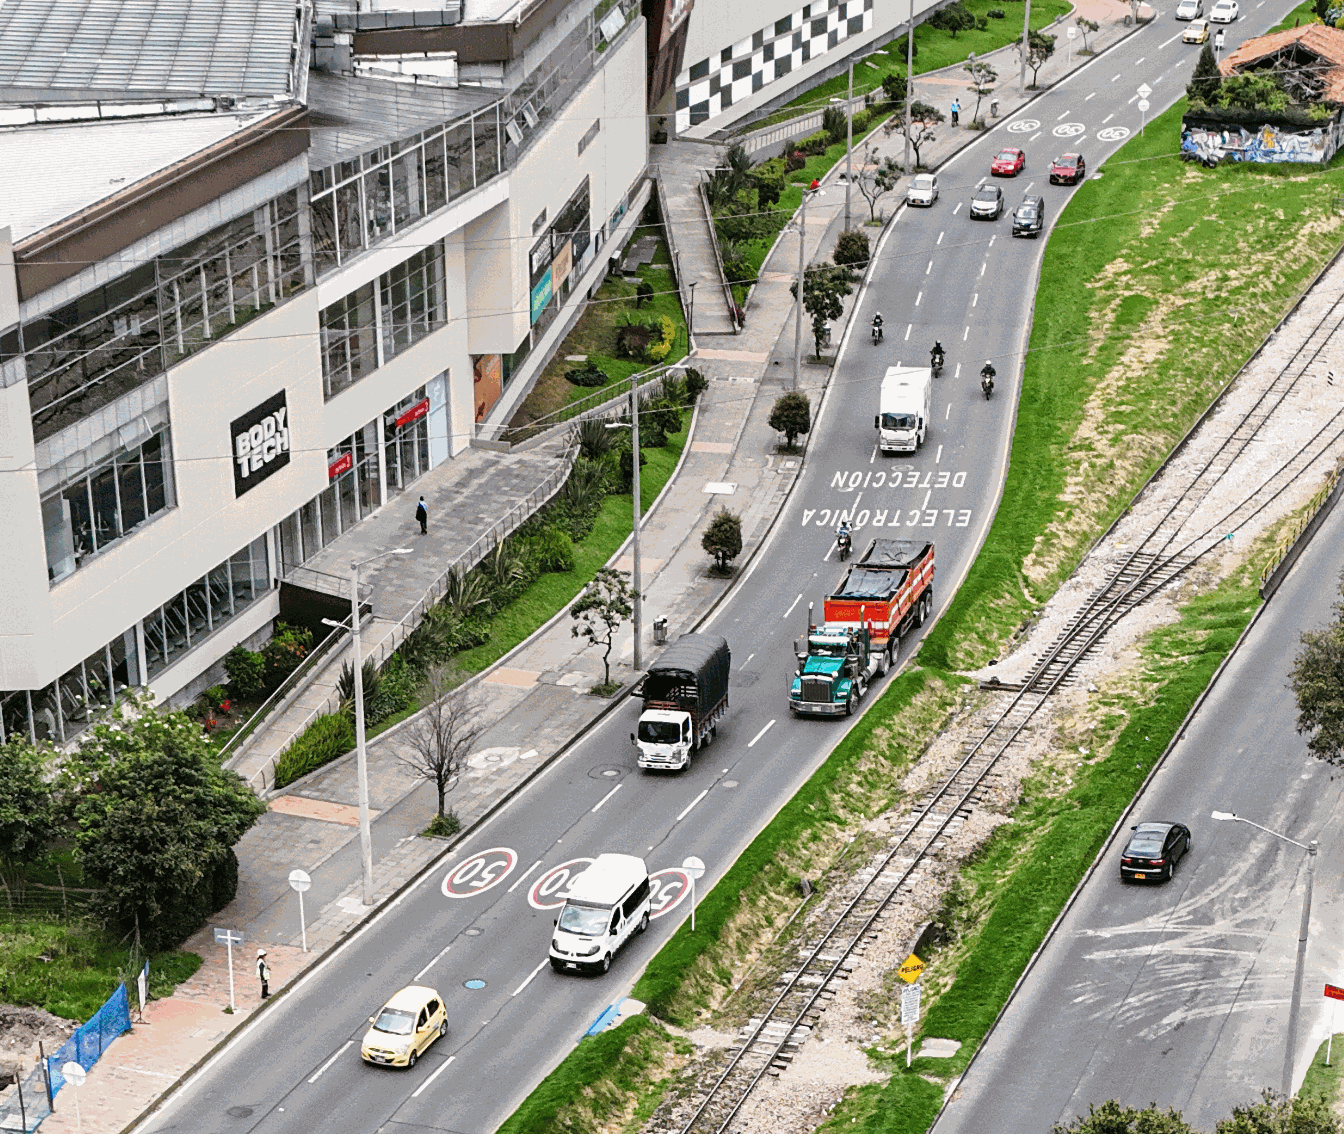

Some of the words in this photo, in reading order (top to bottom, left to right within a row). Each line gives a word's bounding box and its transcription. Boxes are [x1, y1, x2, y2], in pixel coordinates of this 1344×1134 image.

[236, 406, 287, 458] BODY
[237, 427, 289, 478] TECH
[830, 471, 967, 492] DETECCIÓN
[801, 509, 972, 531] ELECTRÓNICA
[452, 857, 508, 888] 50
